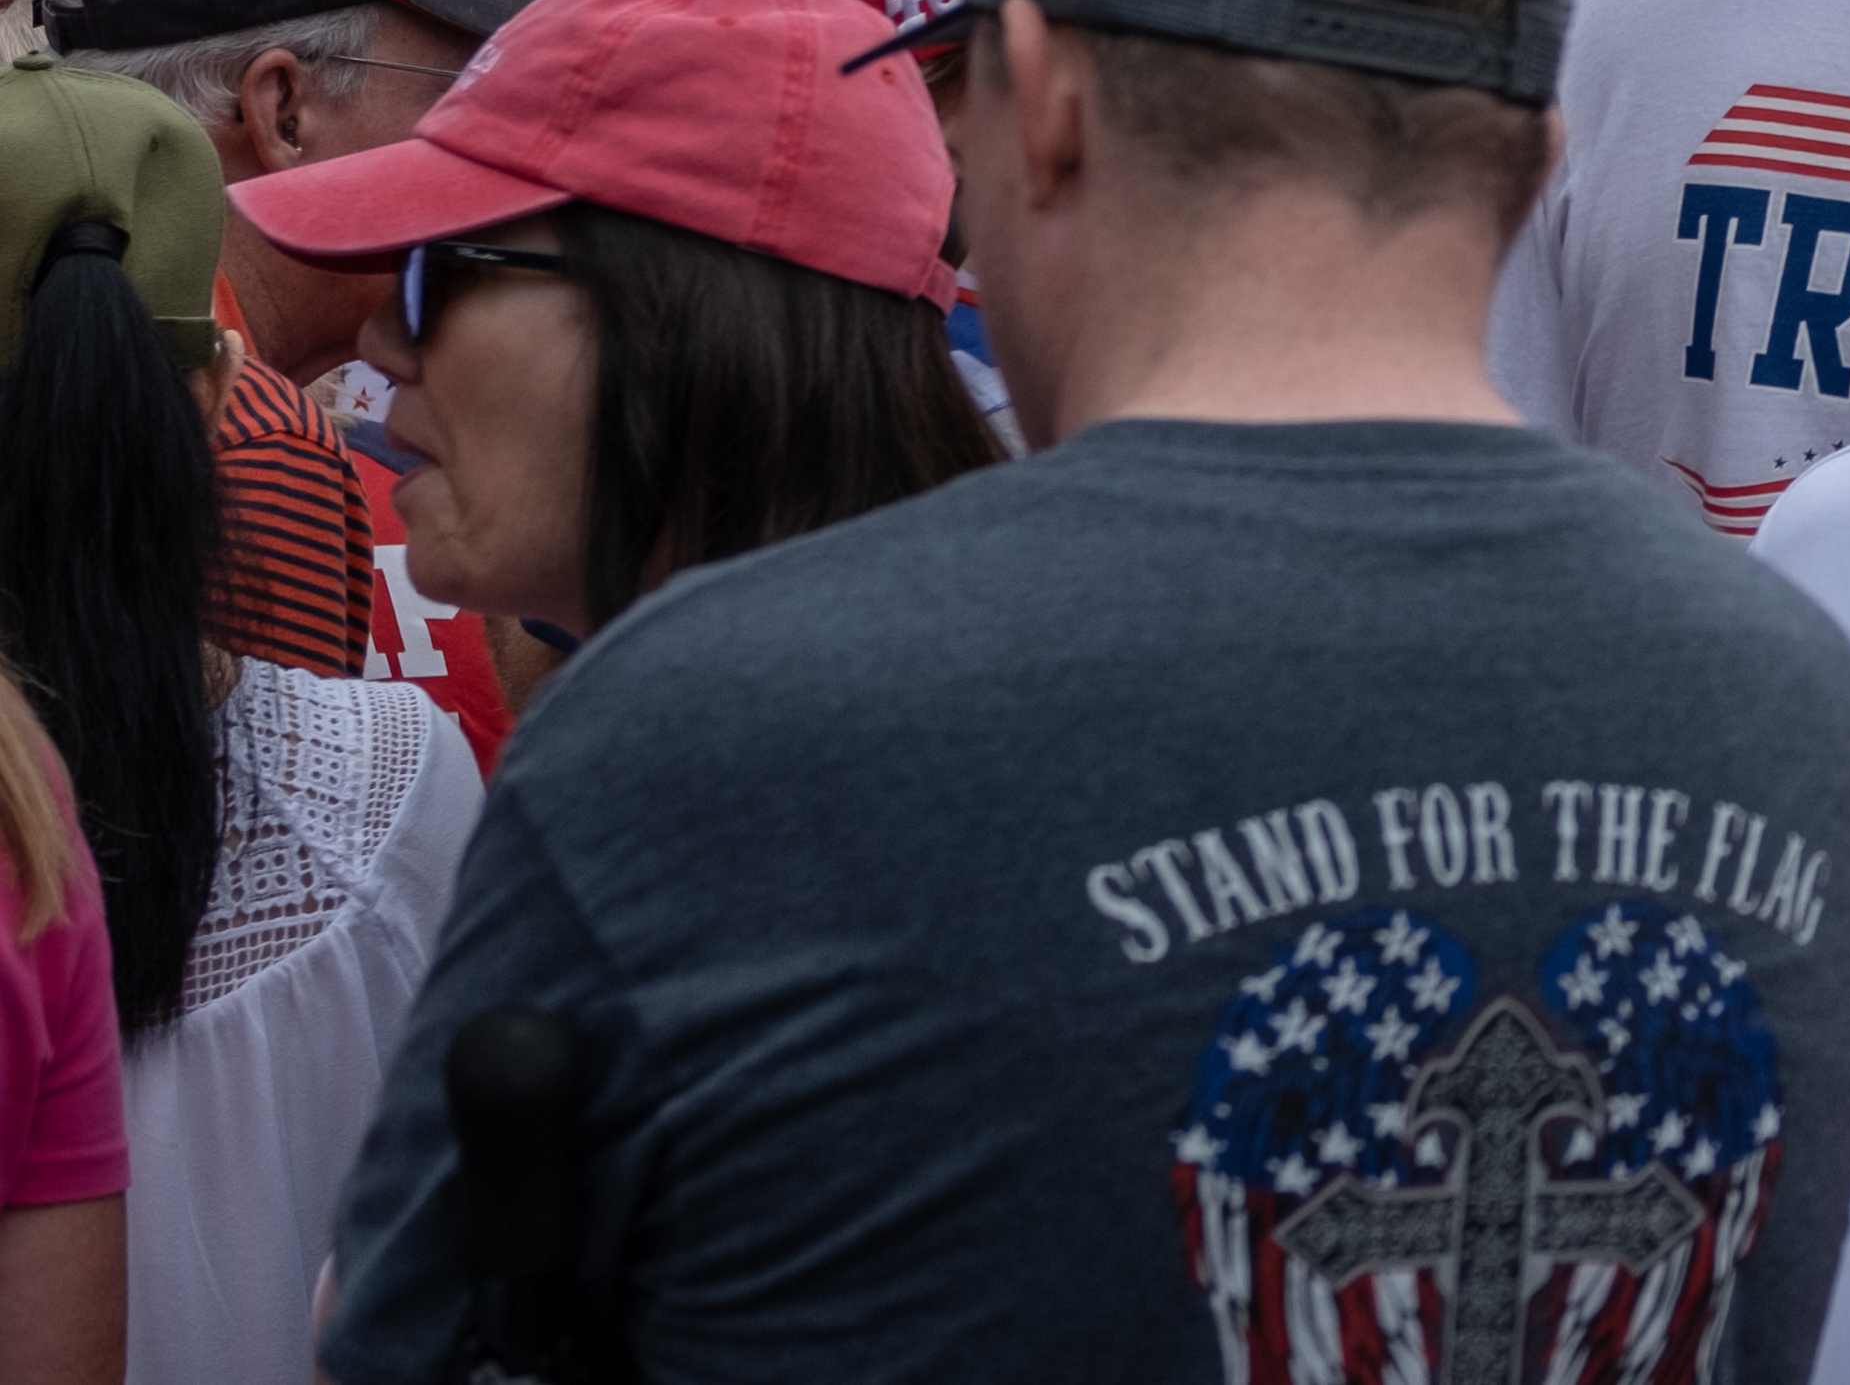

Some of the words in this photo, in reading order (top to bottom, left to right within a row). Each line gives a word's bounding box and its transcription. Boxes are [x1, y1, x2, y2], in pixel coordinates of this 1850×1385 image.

[1085, 796, 1361, 964] STAND
[1372, 782, 1518, 891] FOR
[1542, 779, 1691, 893] THE
[1694, 800, 1832, 947] FLAG
